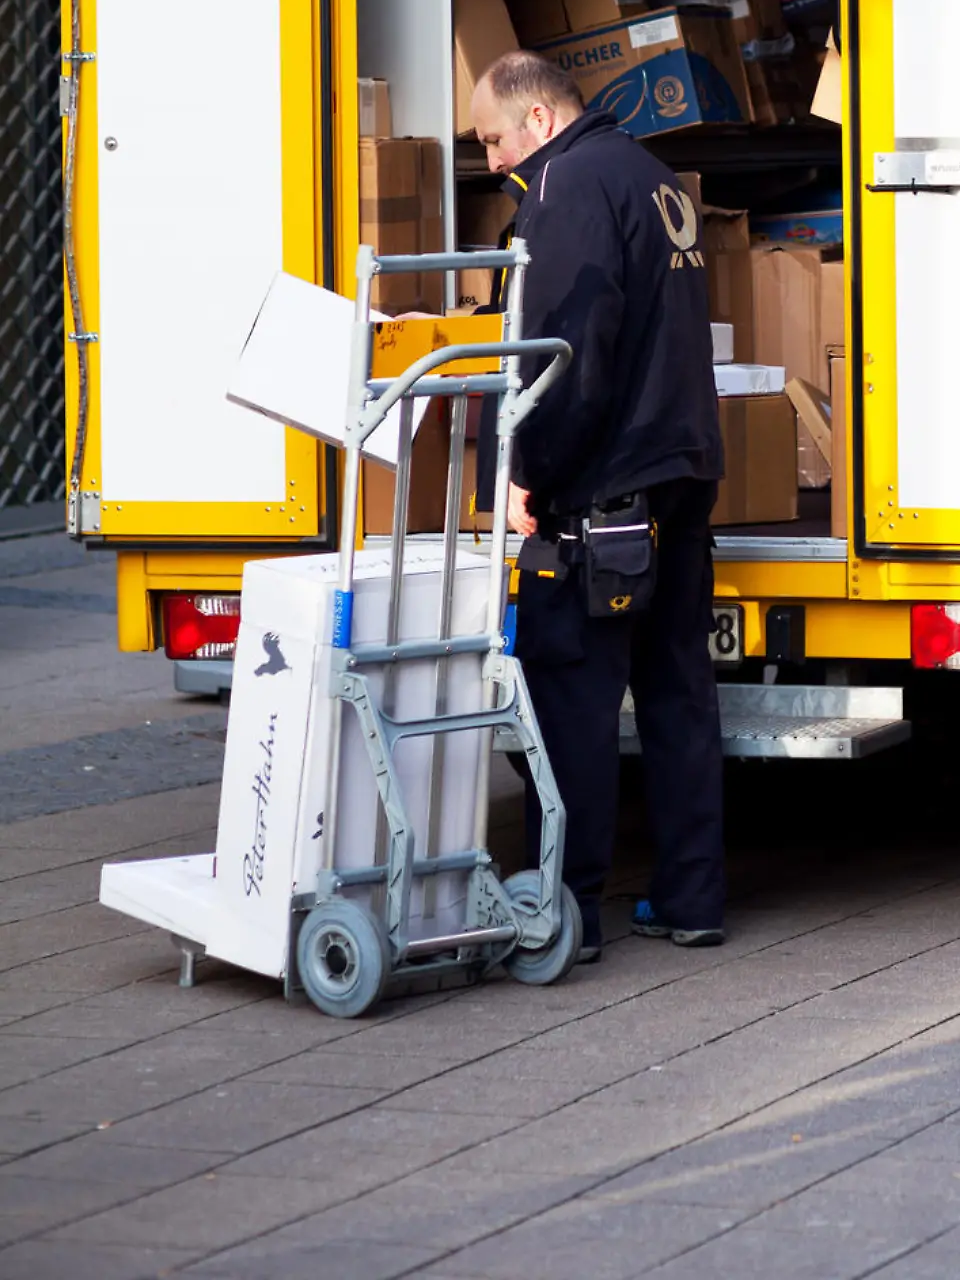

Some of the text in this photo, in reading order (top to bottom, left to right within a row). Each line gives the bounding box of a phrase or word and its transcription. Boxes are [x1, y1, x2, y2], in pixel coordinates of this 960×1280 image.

[714, 613, 736, 654] 8
[242, 711, 279, 897] Peter Hahn
